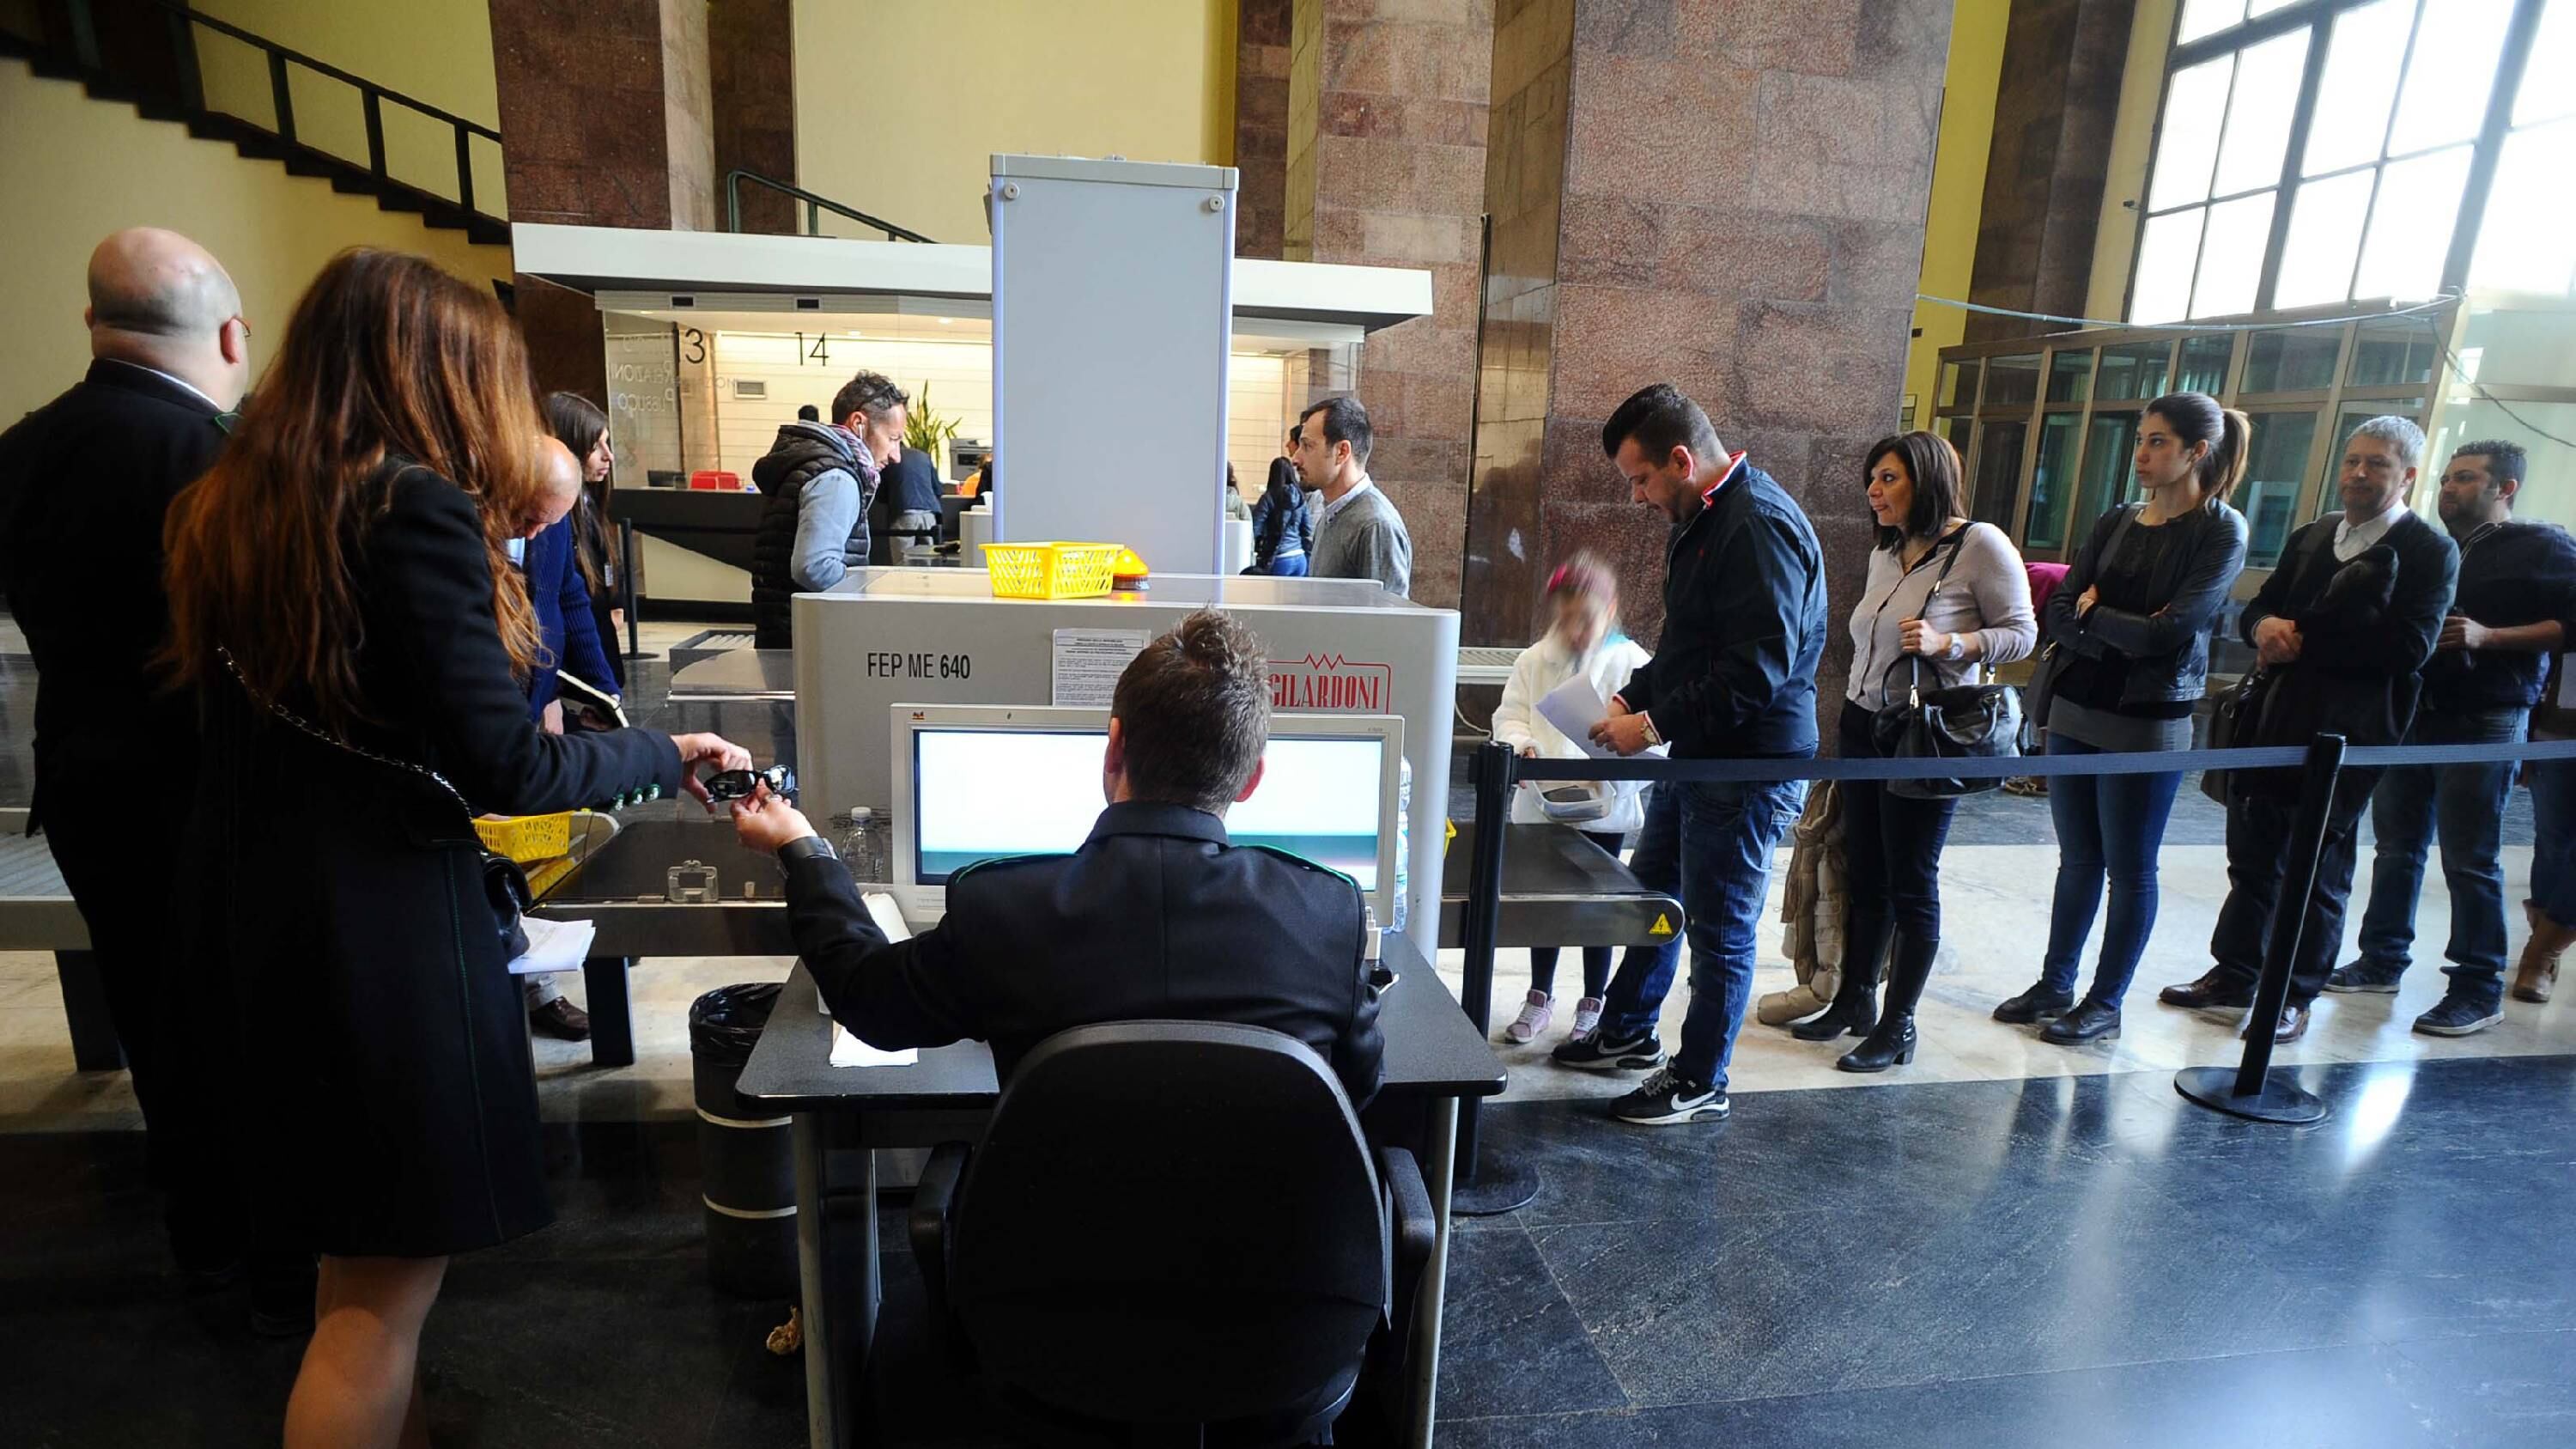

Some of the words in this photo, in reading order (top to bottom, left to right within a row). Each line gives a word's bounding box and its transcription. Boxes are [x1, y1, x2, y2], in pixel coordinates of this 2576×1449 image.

[794, 332, 829, 367] 14
[867, 653, 902, 677] FEP
[908, 654, 933, 678] ME
[940, 654, 970, 679] 640
[1269, 673, 1379, 709] GILARDONI
